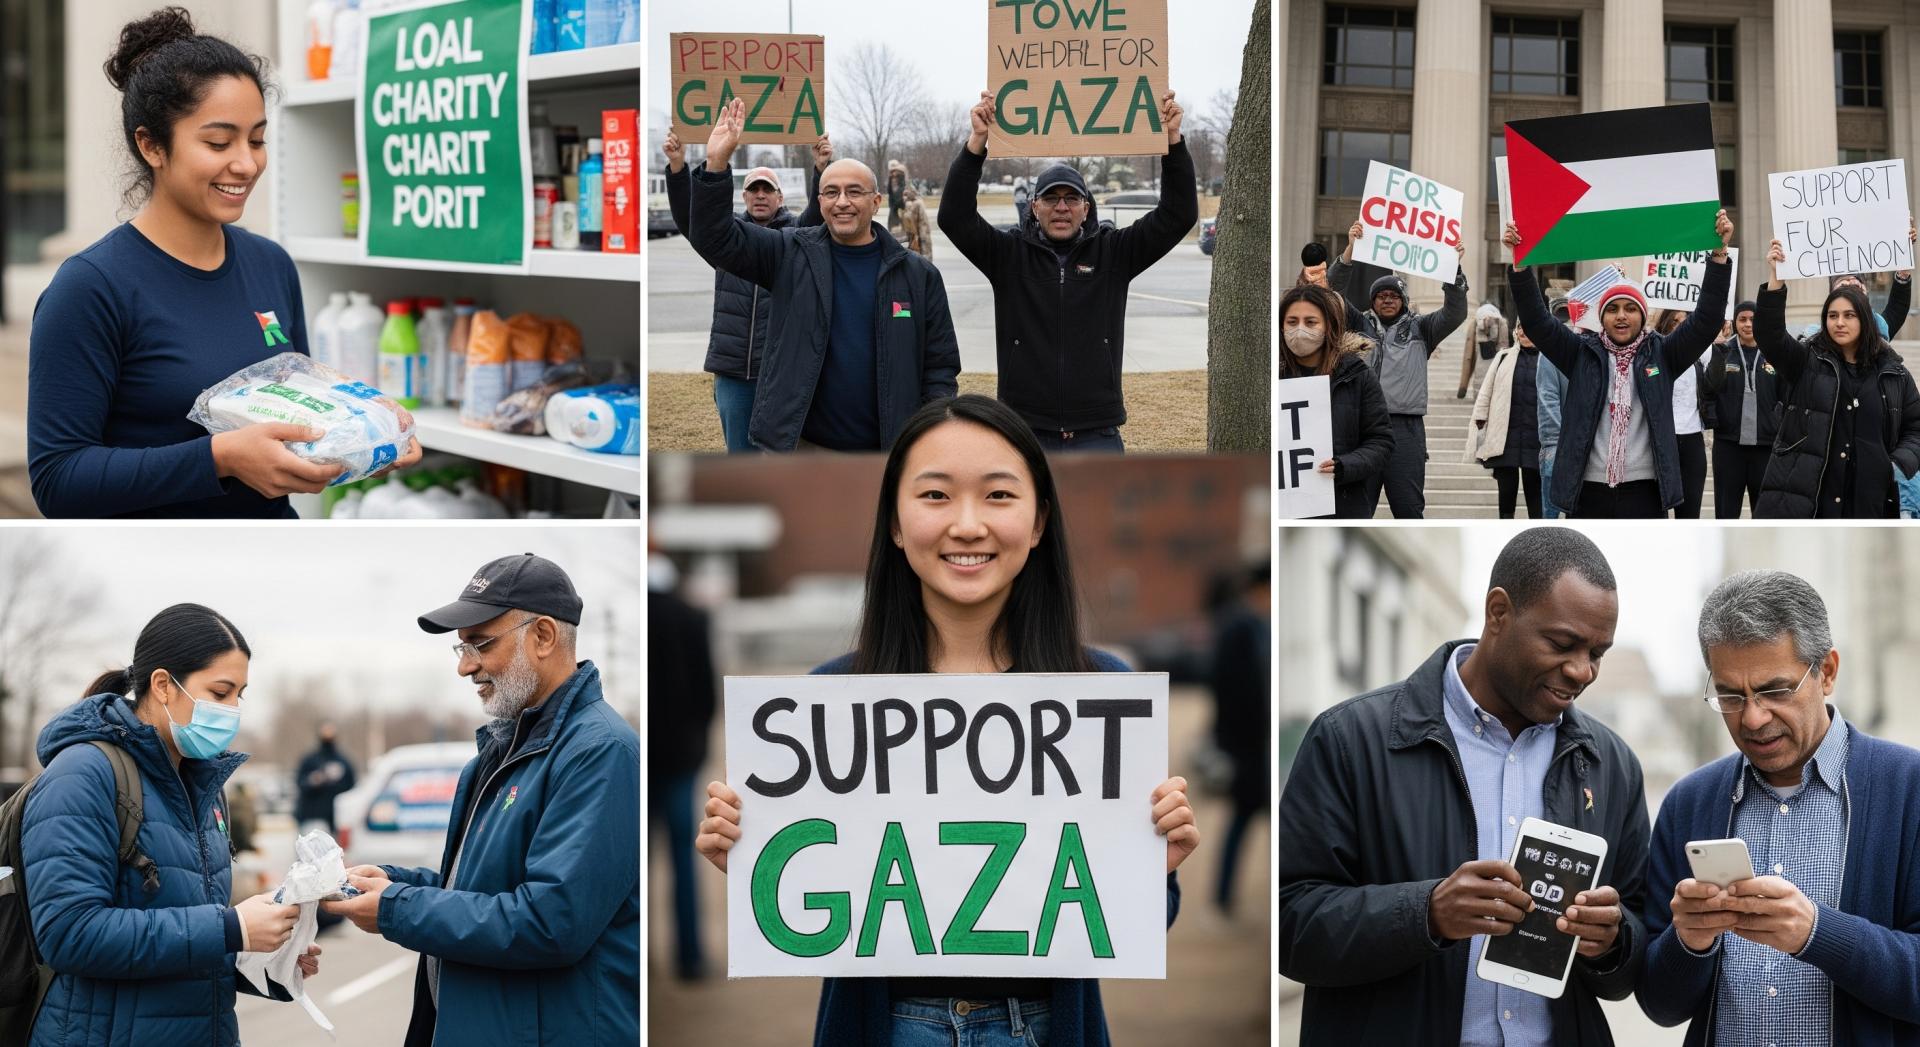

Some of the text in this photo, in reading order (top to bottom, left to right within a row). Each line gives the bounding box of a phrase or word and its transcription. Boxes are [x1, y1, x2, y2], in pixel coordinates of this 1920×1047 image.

[395, 17, 484, 72] LOAL
[679, 38, 824, 73] PERPORT
[1103, 38, 1159, 72] FOR
[372, 71, 509, 127] CHARITY
[995, 75, 1163, 135] GAZA
[382, 130, 491, 177] CHARIT
[392, 184, 486, 230] PORIT
[1385, 168, 1443, 210] FOR
[1782, 165, 1897, 209] SUPPORT
[1362, 196, 1461, 247] CRISIS
[1786, 217, 1849, 252] FUR
[745, 697, 1153, 799] SUPPORT
[750, 817, 1116, 959] GAZA
